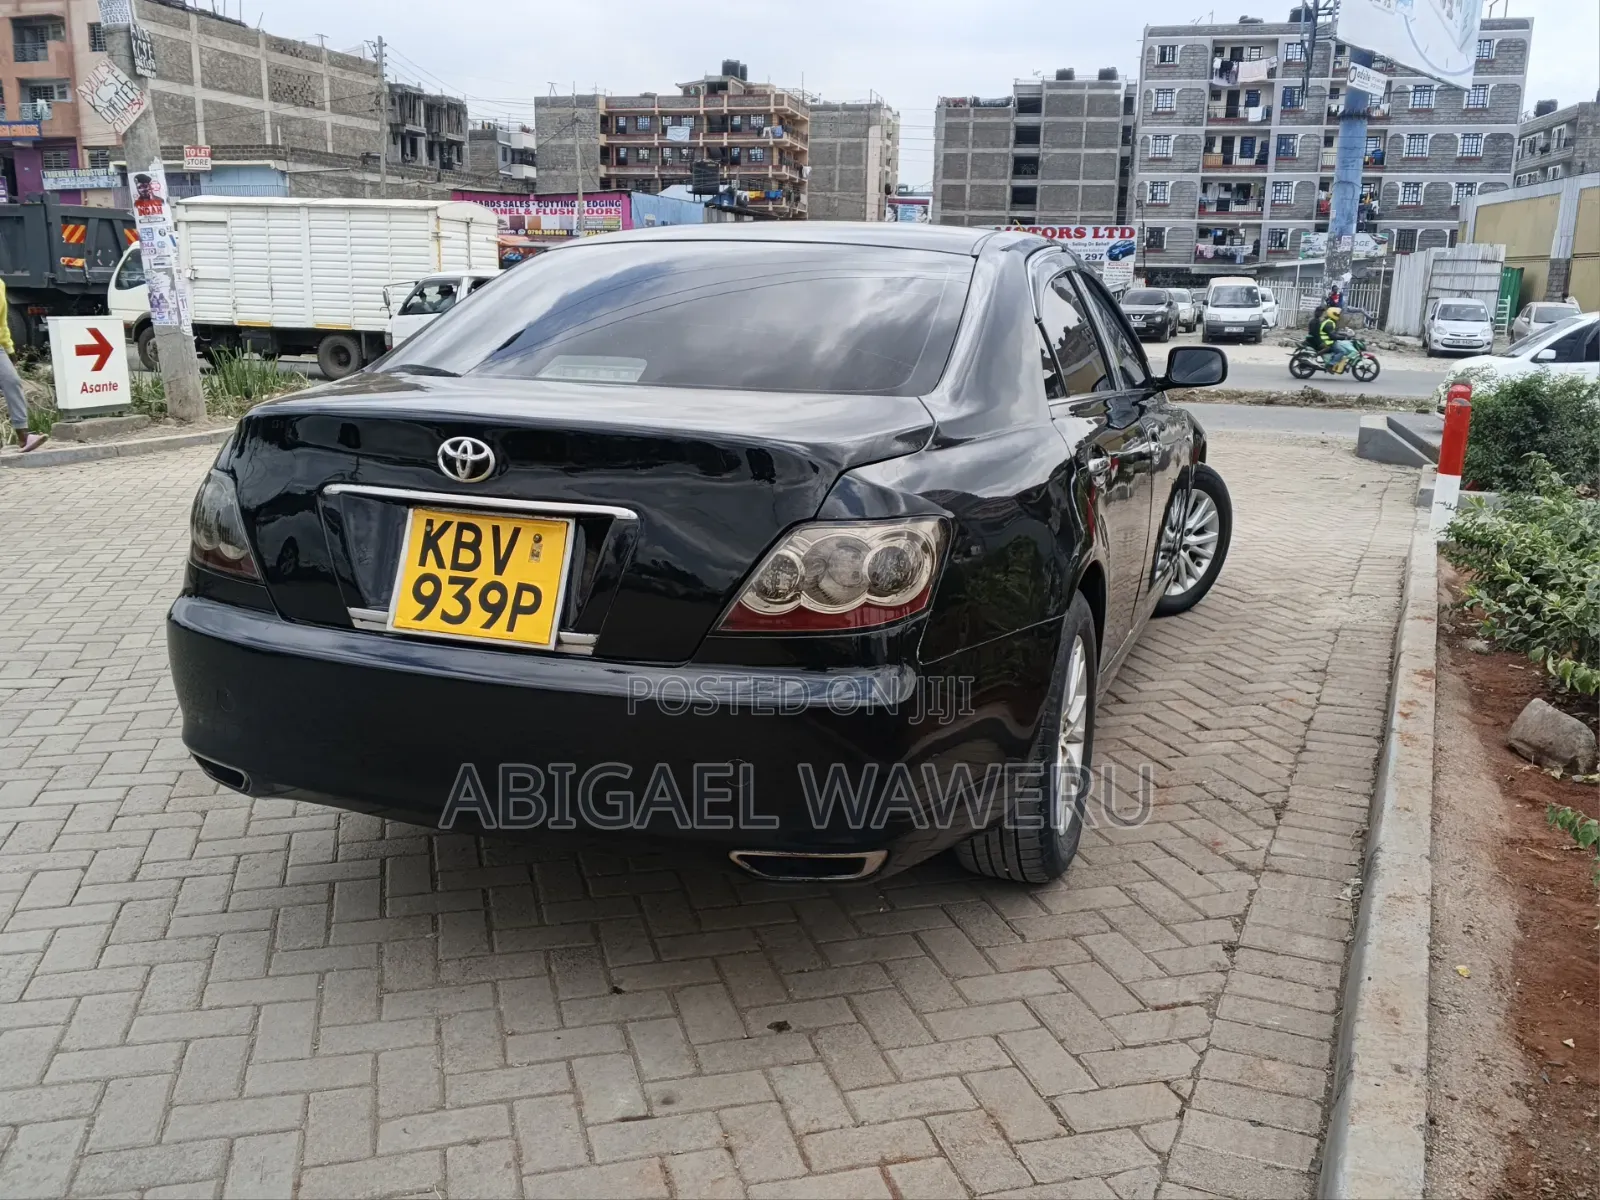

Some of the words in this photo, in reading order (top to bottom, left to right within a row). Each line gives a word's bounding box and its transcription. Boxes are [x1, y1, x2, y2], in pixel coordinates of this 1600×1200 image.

[185, 148, 196, 156] TO
[197, 148, 210, 156] LET
[187, 158, 208, 166] STORE
[473, 200, 502, 208] ARDS
[503, 200, 530, 208] SALES
[537, 200, 576, 208] CUTTING
[586, 200, 621, 208] EDGING
[994, 226, 1087, 239] TORS
[1092, 226, 1136, 239] LTD
[80, 380, 119, 395] Asante
[418, 518, 522, 576] KBV
[411, 572, 543, 632] 939P
